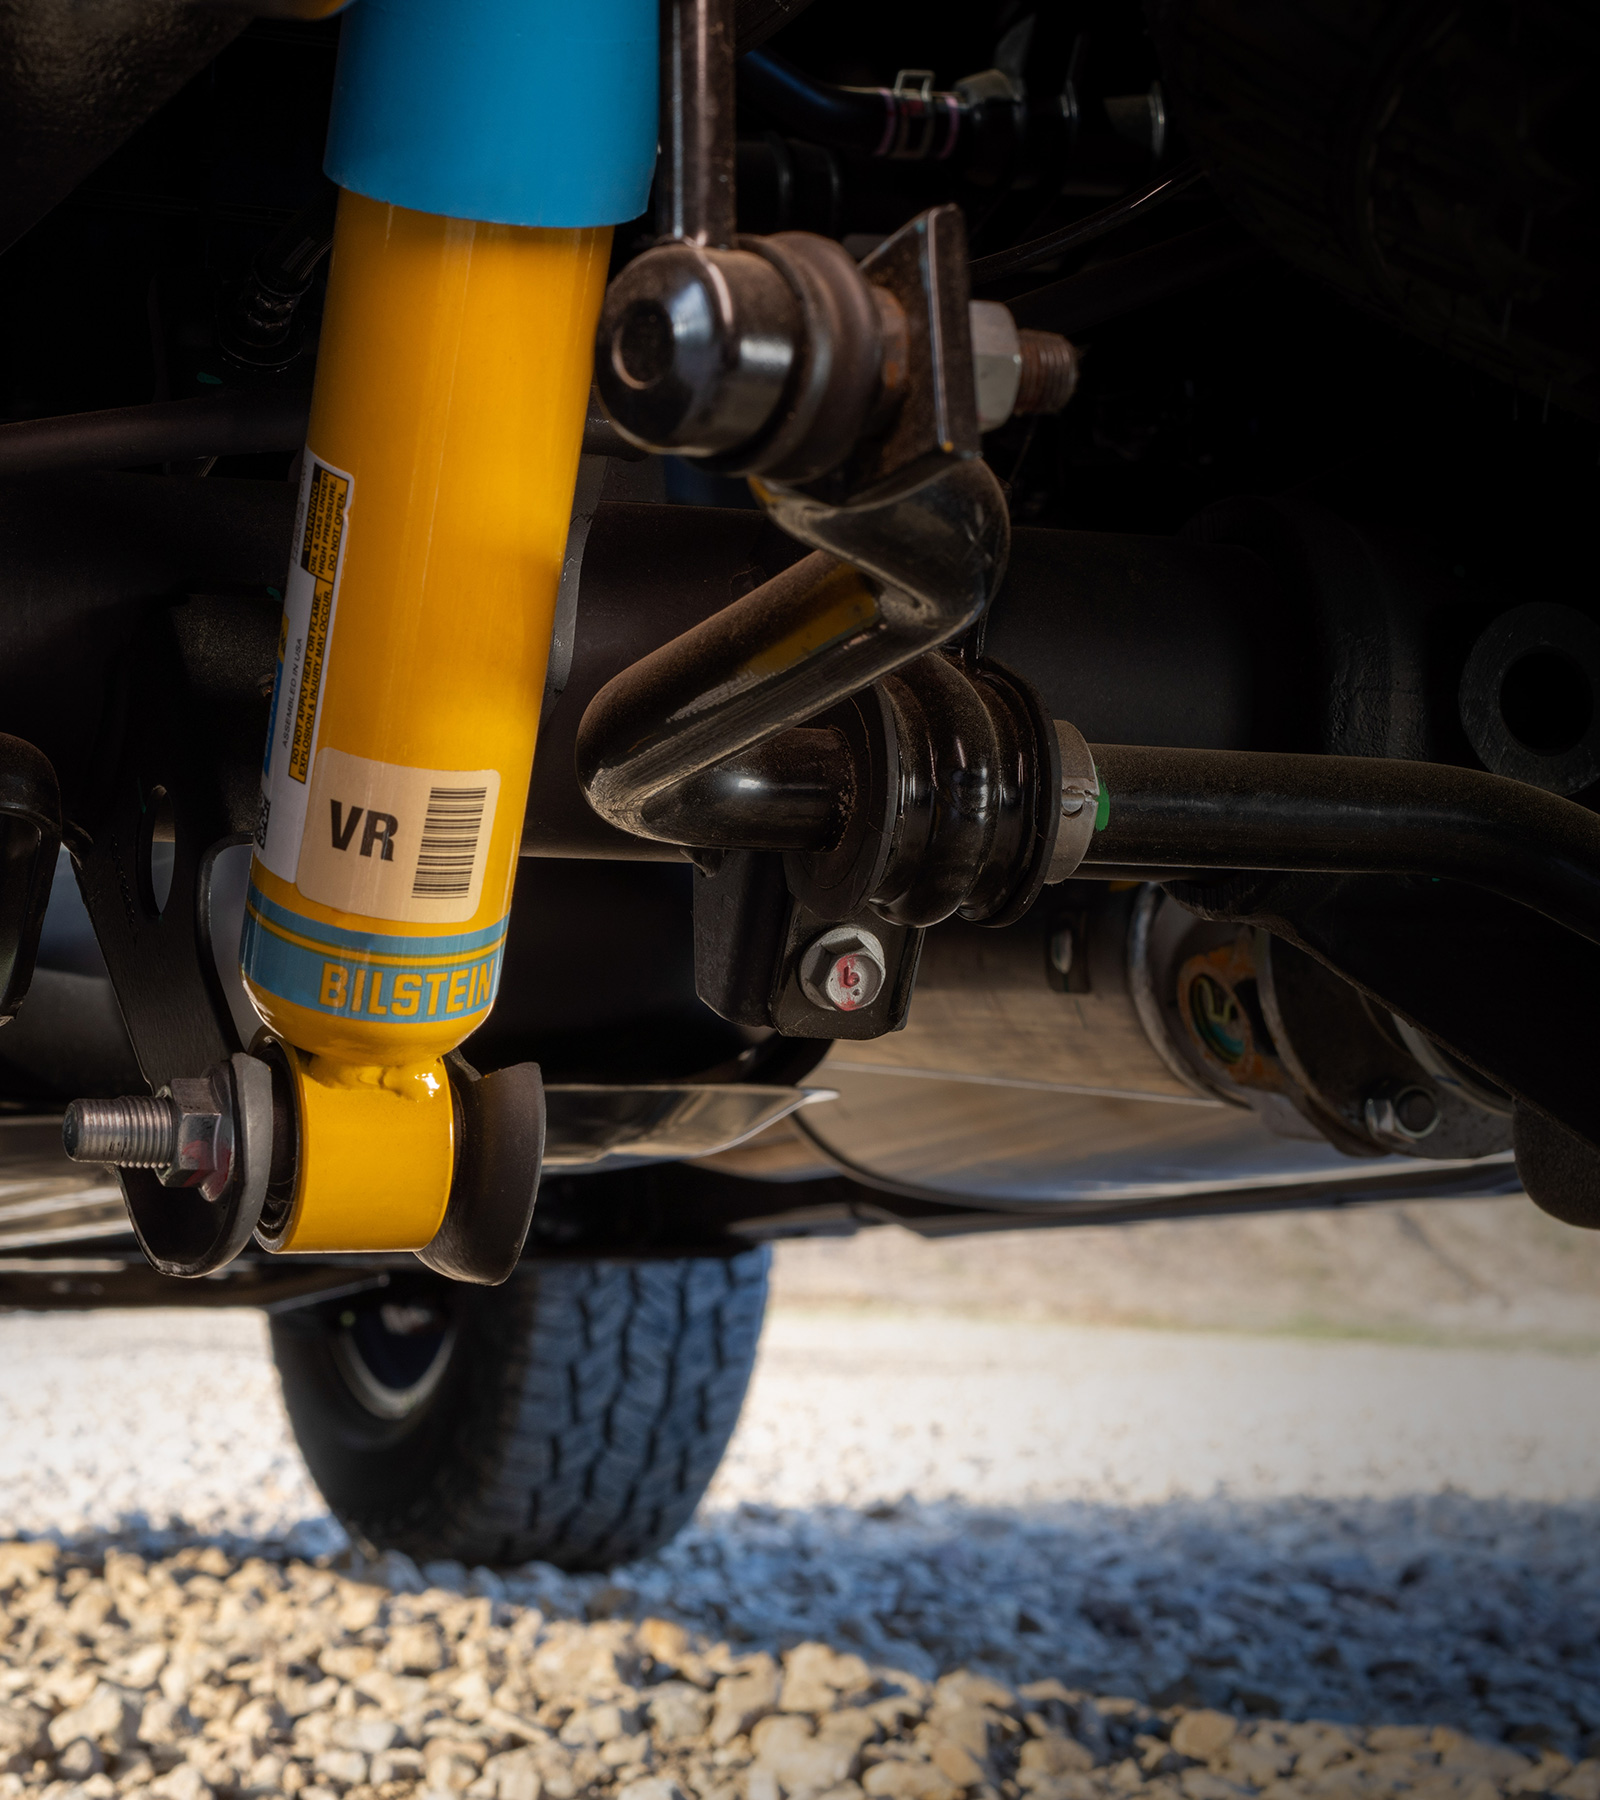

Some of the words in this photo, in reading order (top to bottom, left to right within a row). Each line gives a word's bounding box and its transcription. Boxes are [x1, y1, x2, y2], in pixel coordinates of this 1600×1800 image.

[304, 480, 319, 552] WARNING
[310, 554, 318, 572] OIL
[315, 516, 323, 539] GAS
[319, 473, 328, 512] UNDER
[335, 492, 345, 525] OPEN.
[318, 545, 328, 575] HIGH
[323, 480, 337, 544] PRESSURE.
[331, 528, 341, 552] NOT
[327, 554, 336, 571] DO
[311, 593, 322, 633] FLAME.
[318, 589, 332, 632] OCCUR.
[294, 638, 303, 661] USA
[307, 635, 316, 652] OR
[314, 634, 325, 658] MAY
[292, 663, 299, 677] IN
[304, 653, 312, 684] HEAT
[308, 660, 321, 701] INJURY
[282, 677, 298, 749] ASSEMBLED
[298, 686, 308, 722] APPLY
[307, 703, 315, 711] &
[294, 721, 304, 746] NOT
[299, 713, 313, 776] EXPLOSION
[291, 747, 300, 765] DO
[330, 799, 398, 862] VR
[318, 958, 496, 1016] BILSTEIN
